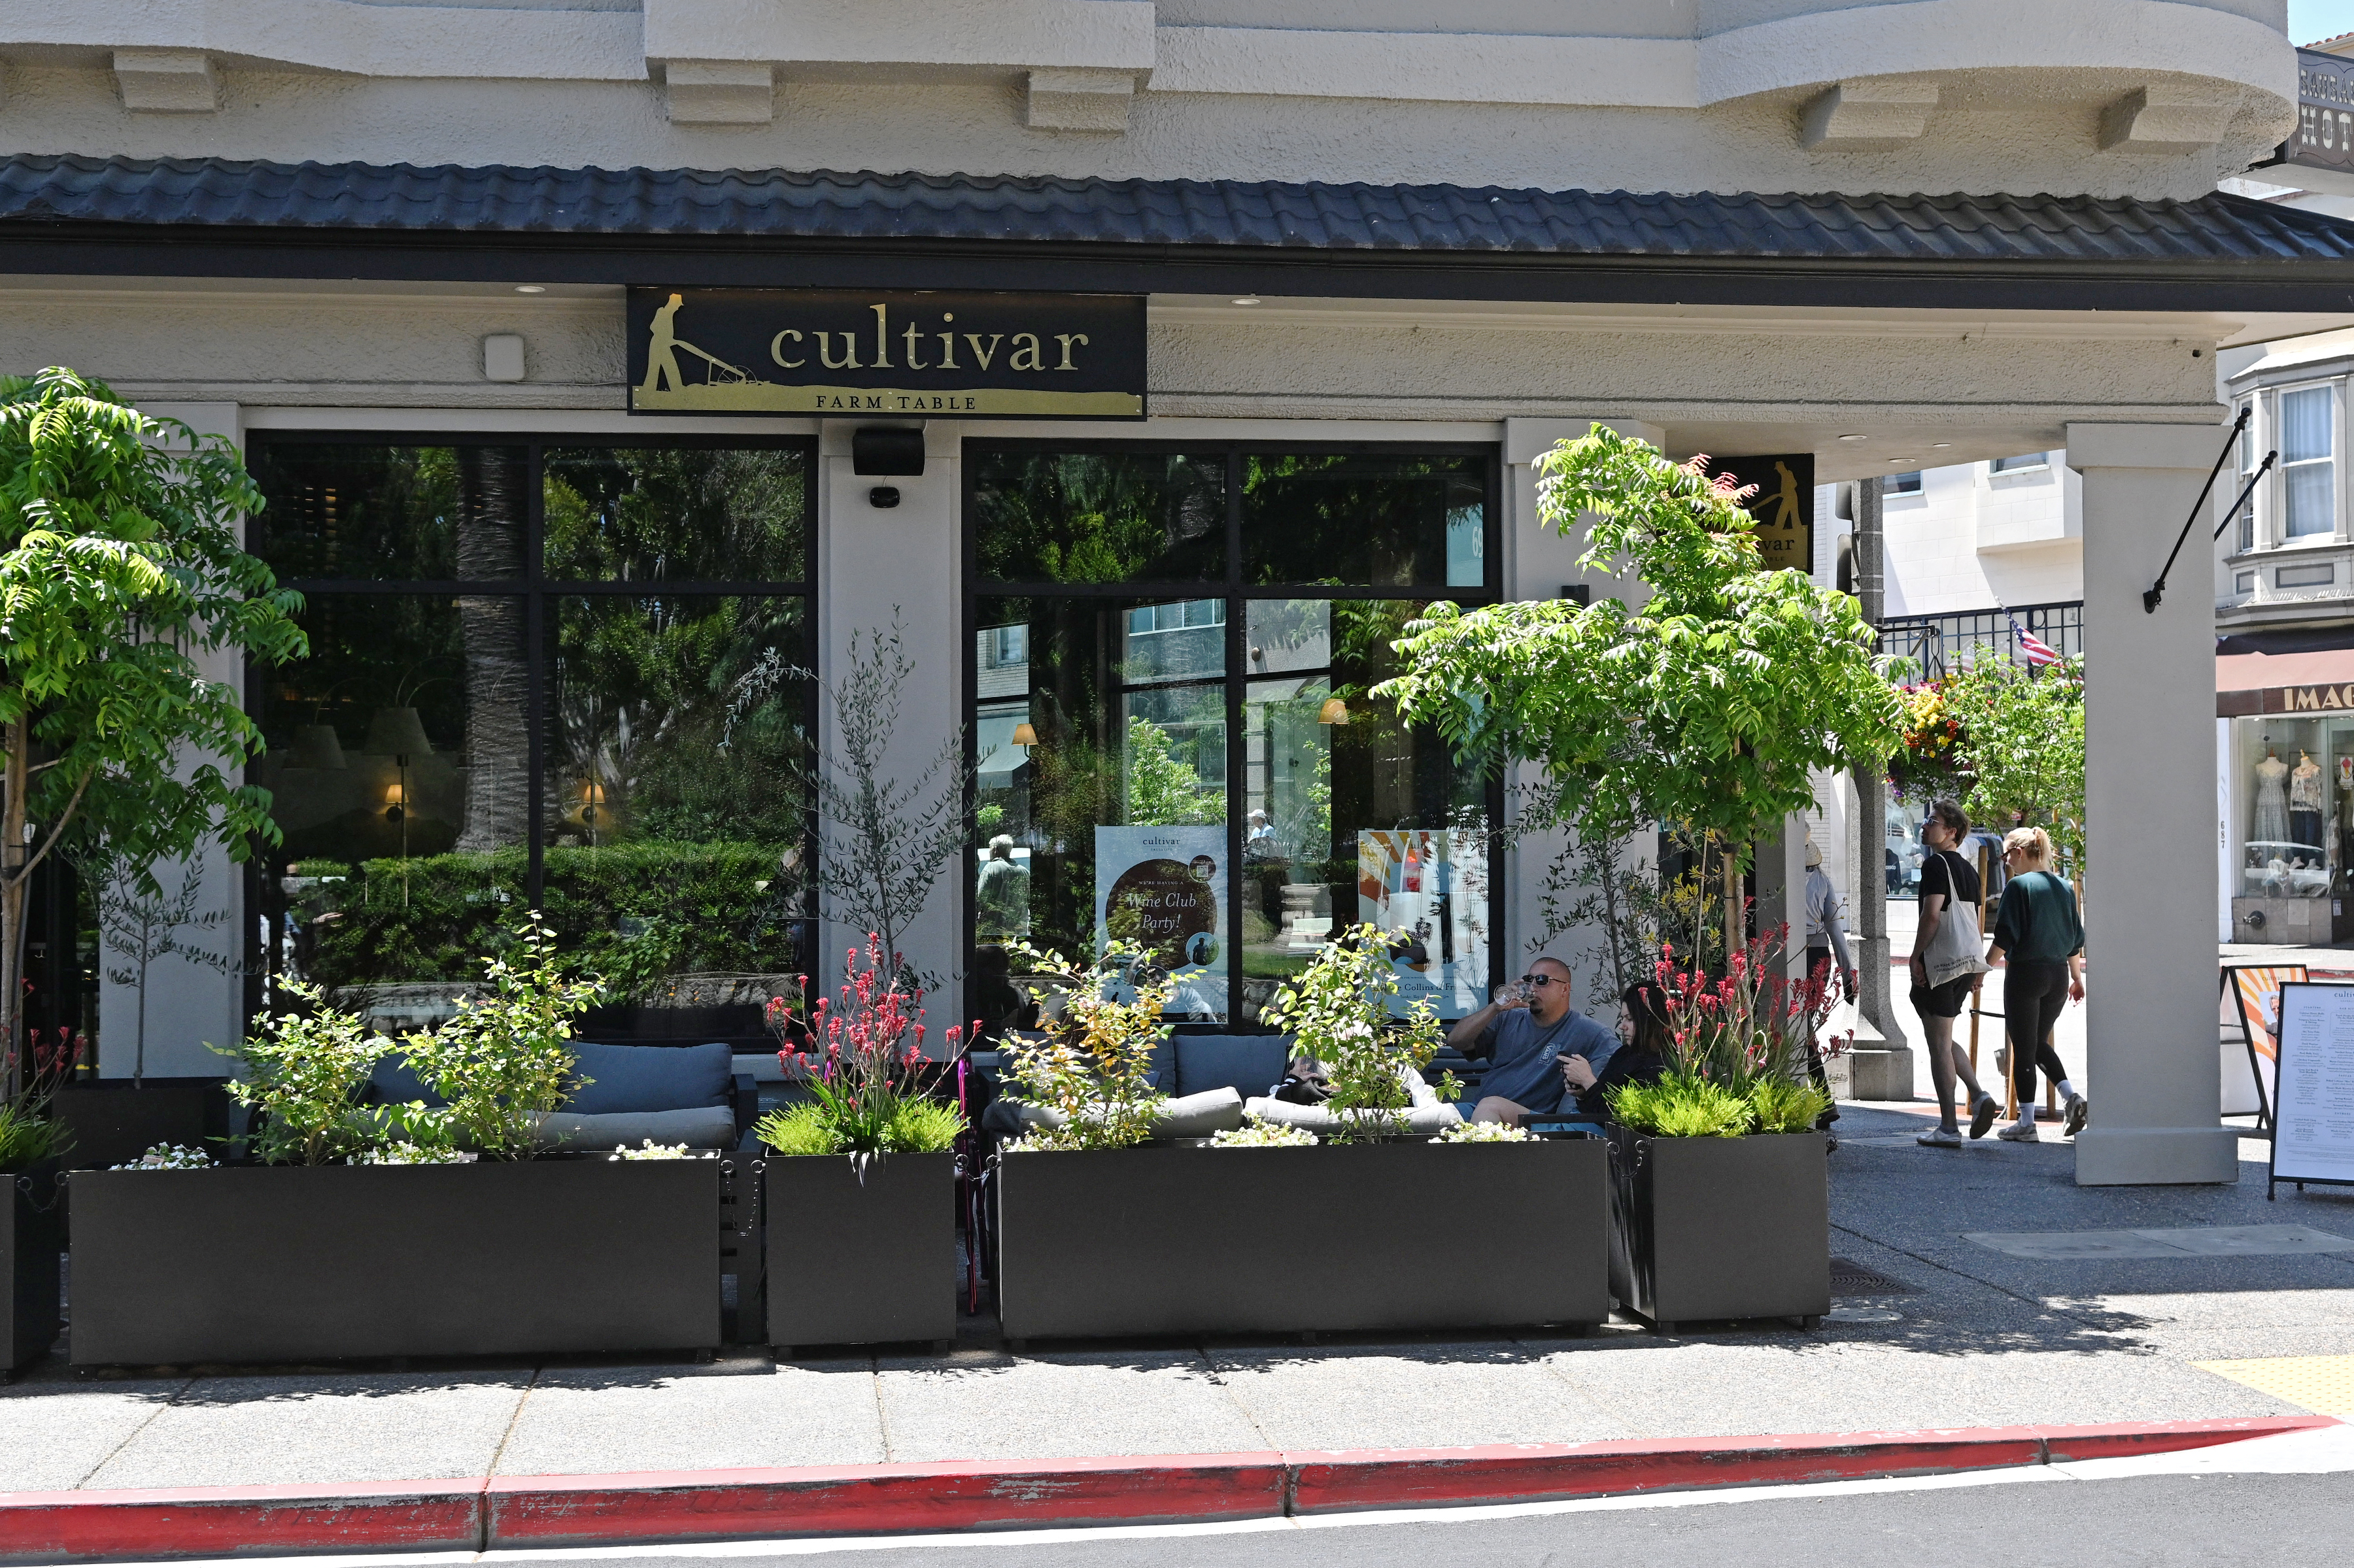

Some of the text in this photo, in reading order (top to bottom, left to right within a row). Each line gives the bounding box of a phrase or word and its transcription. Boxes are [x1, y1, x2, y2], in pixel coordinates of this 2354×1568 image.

[2301, 105, 2353, 152] HOT
[770, 303, 1089, 371] cultivar
[816, 395, 976, 410] FARM TABLE
[1143, 836, 1180, 845] cultivar
[1128, 892, 1197, 908] Wine Club
[1141, 913, 1181, 934] Party!
[1405, 983, 1433, 991] Collins
[1542, 1045, 1553, 1060] VANS
